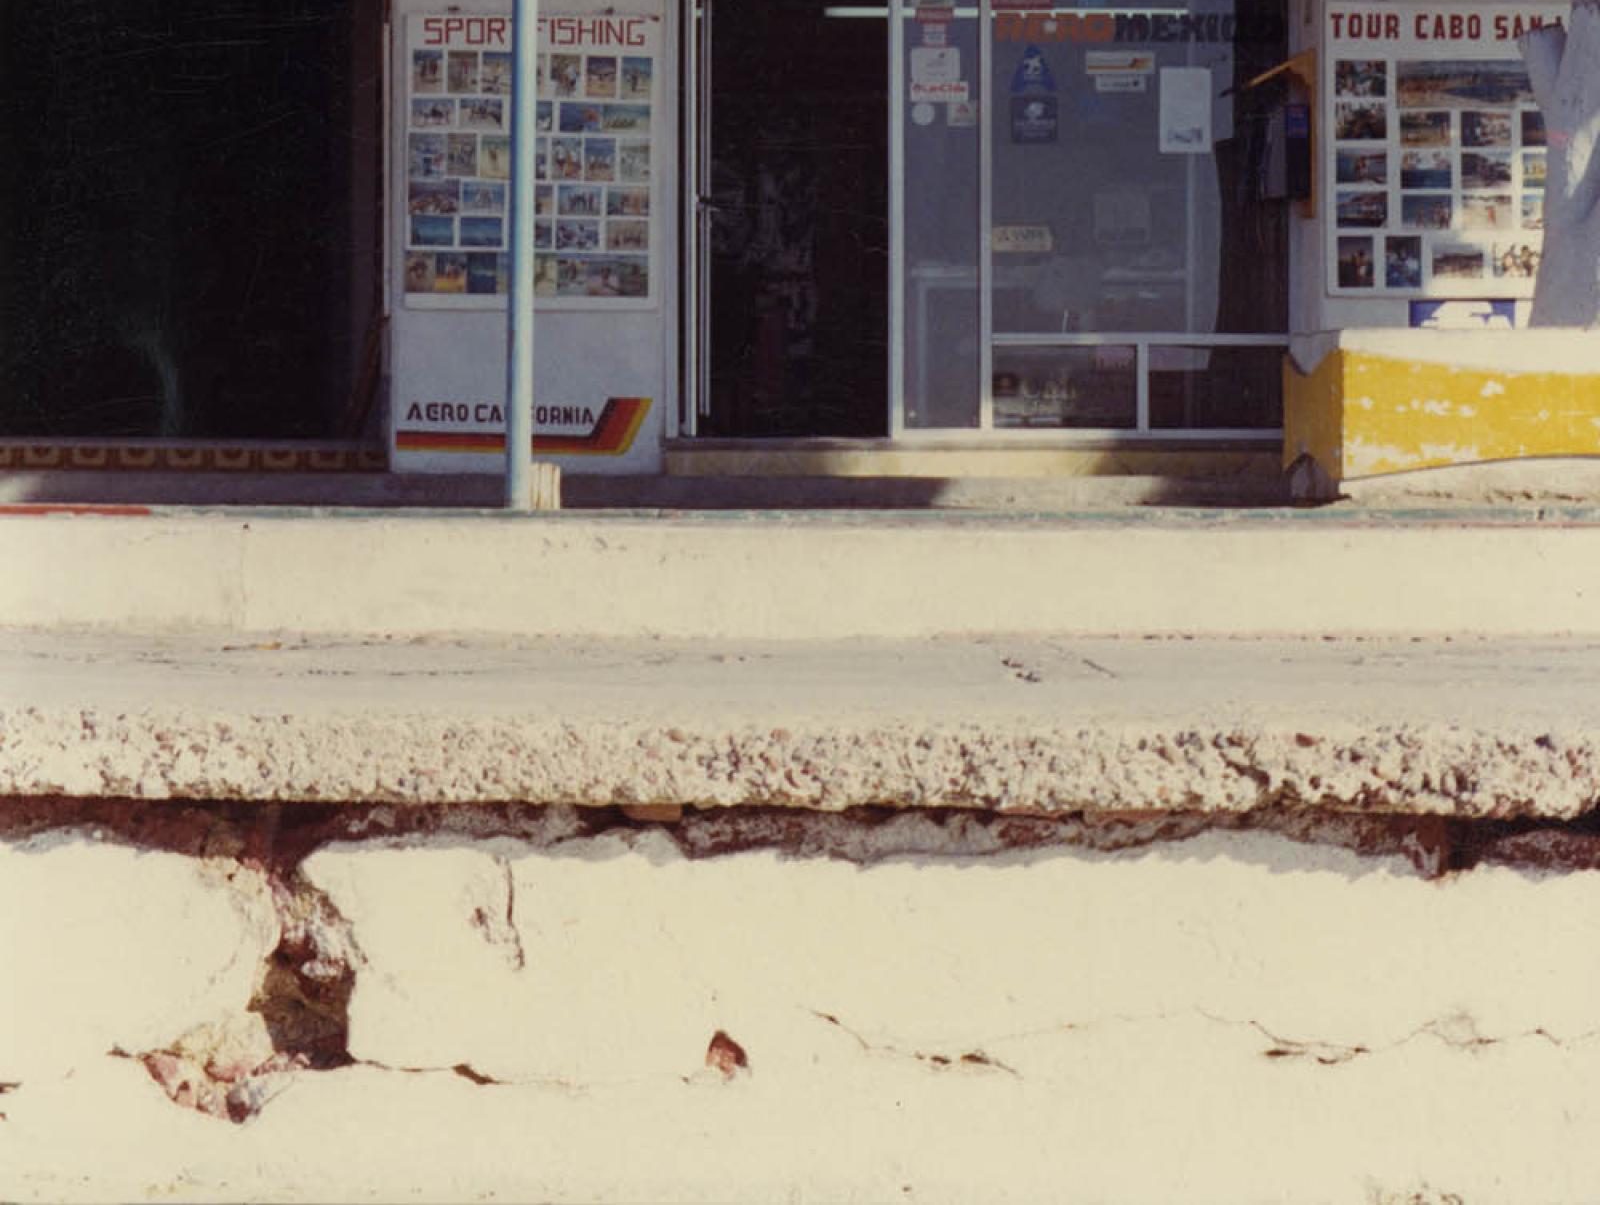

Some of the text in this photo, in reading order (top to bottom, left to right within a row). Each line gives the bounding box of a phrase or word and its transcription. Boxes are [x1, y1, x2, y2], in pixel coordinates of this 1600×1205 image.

[423, 17, 513, 46] SPOR
[1331, 13, 1399, 39] TOUR
[1414, 14, 1481, 40] CABO
[406, 402, 595, 427] AERO CAORNIA
